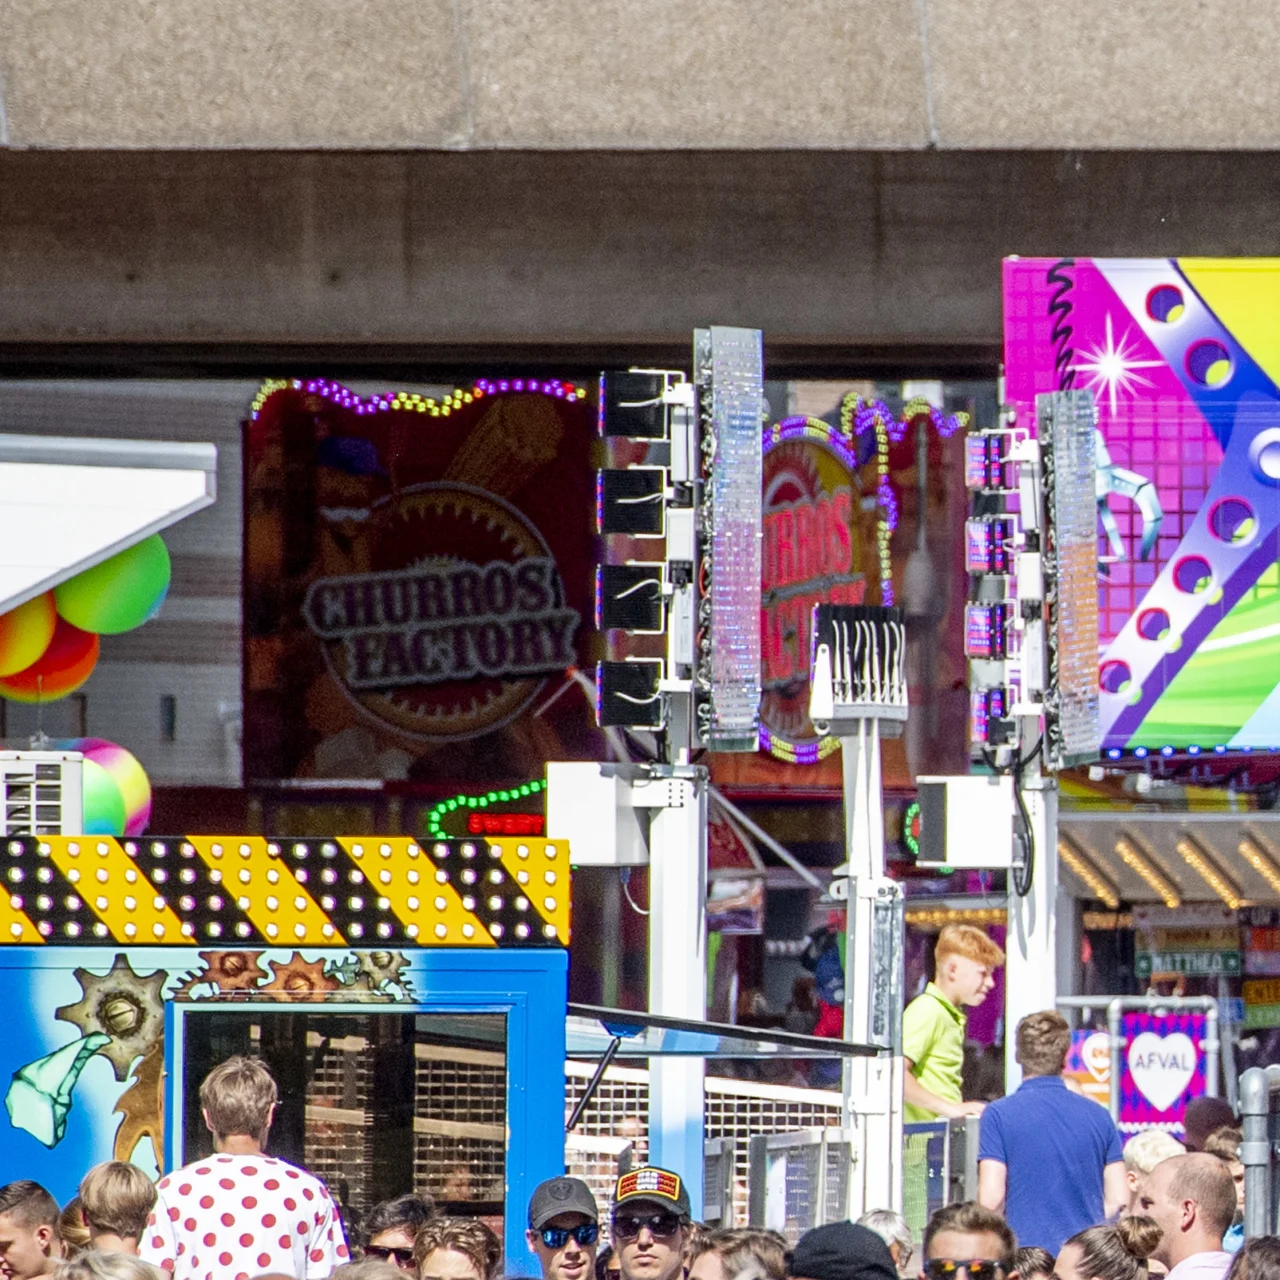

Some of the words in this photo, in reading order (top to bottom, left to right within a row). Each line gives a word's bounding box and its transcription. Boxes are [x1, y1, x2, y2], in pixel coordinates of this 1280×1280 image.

[308, 563, 552, 629] CHURROS
[351, 619, 572, 682] FACTORY
[1134, 1051, 1191, 1072] AFVAL
